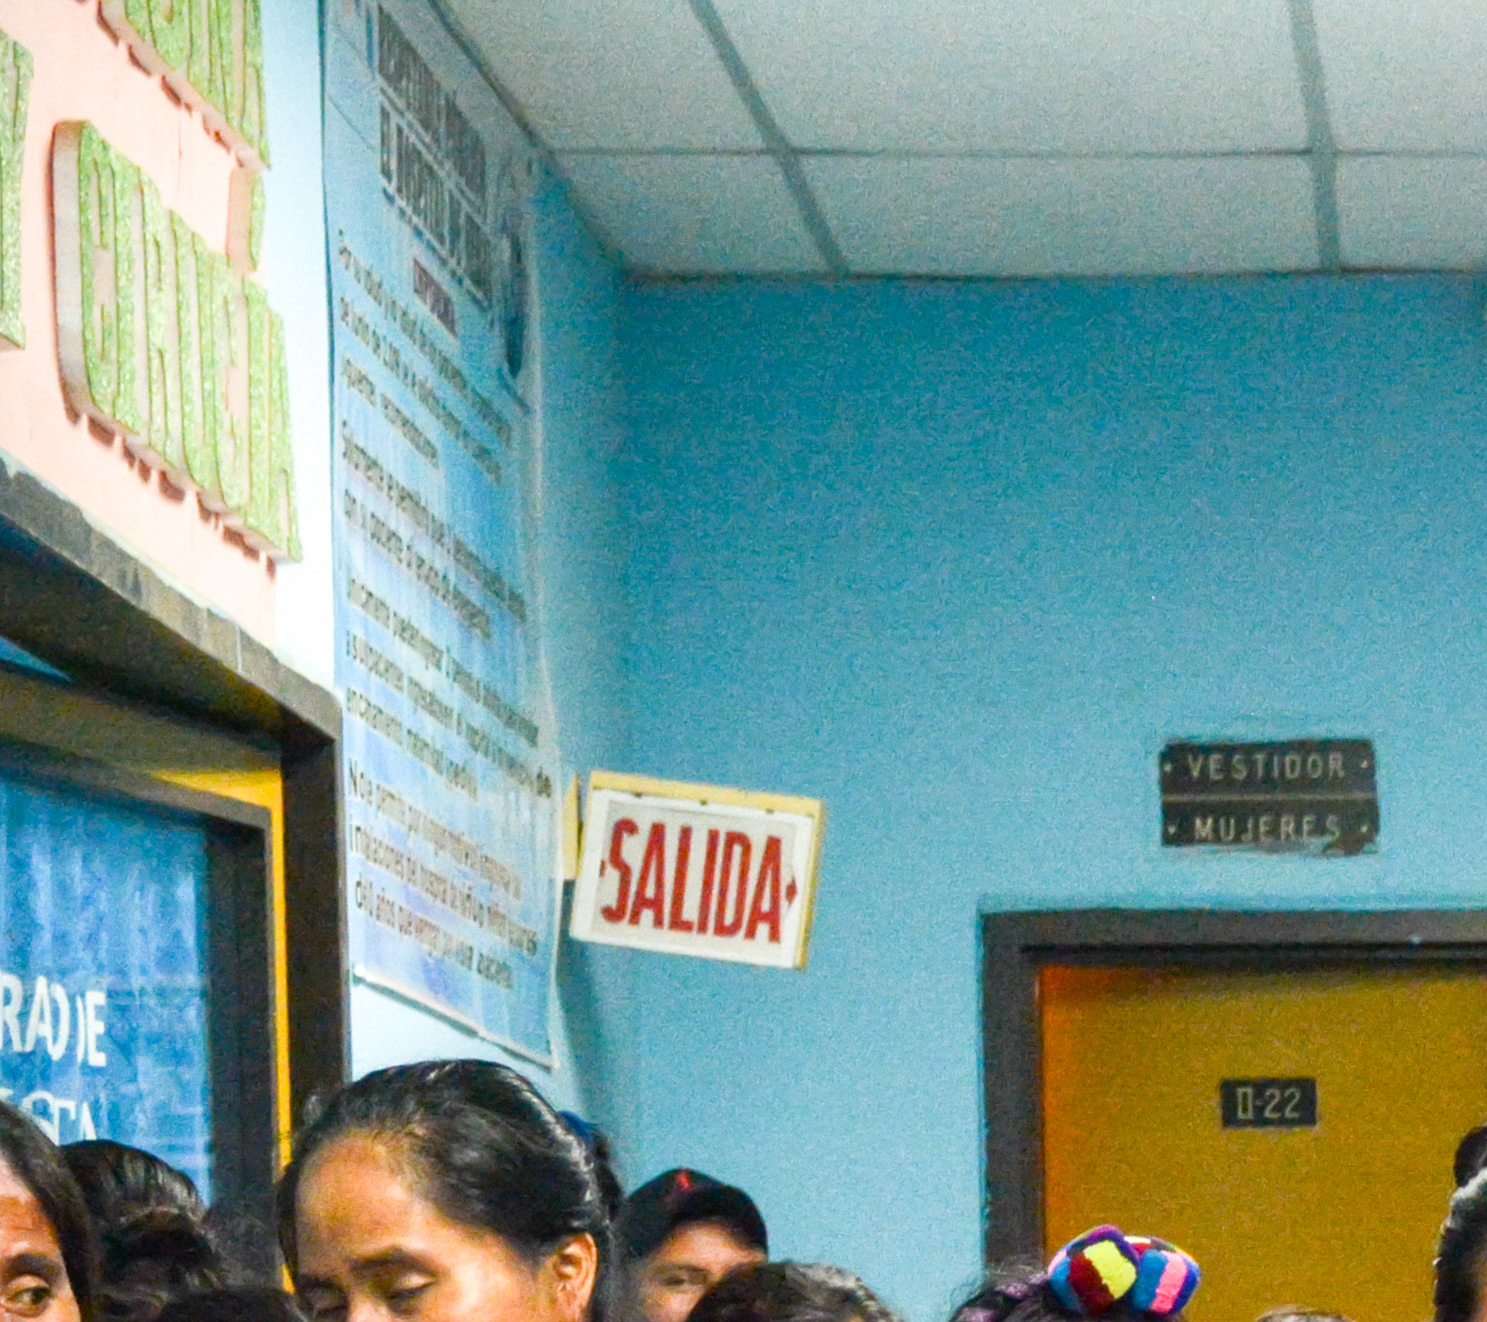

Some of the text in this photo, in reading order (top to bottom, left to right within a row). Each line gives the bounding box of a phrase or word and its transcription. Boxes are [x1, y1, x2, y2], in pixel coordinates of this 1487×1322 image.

[1188, 752, 1345, 781] VESTIDOR
[1194, 815, 1341, 842] MUJERES
[600, 817, 782, 944] SALIDA
